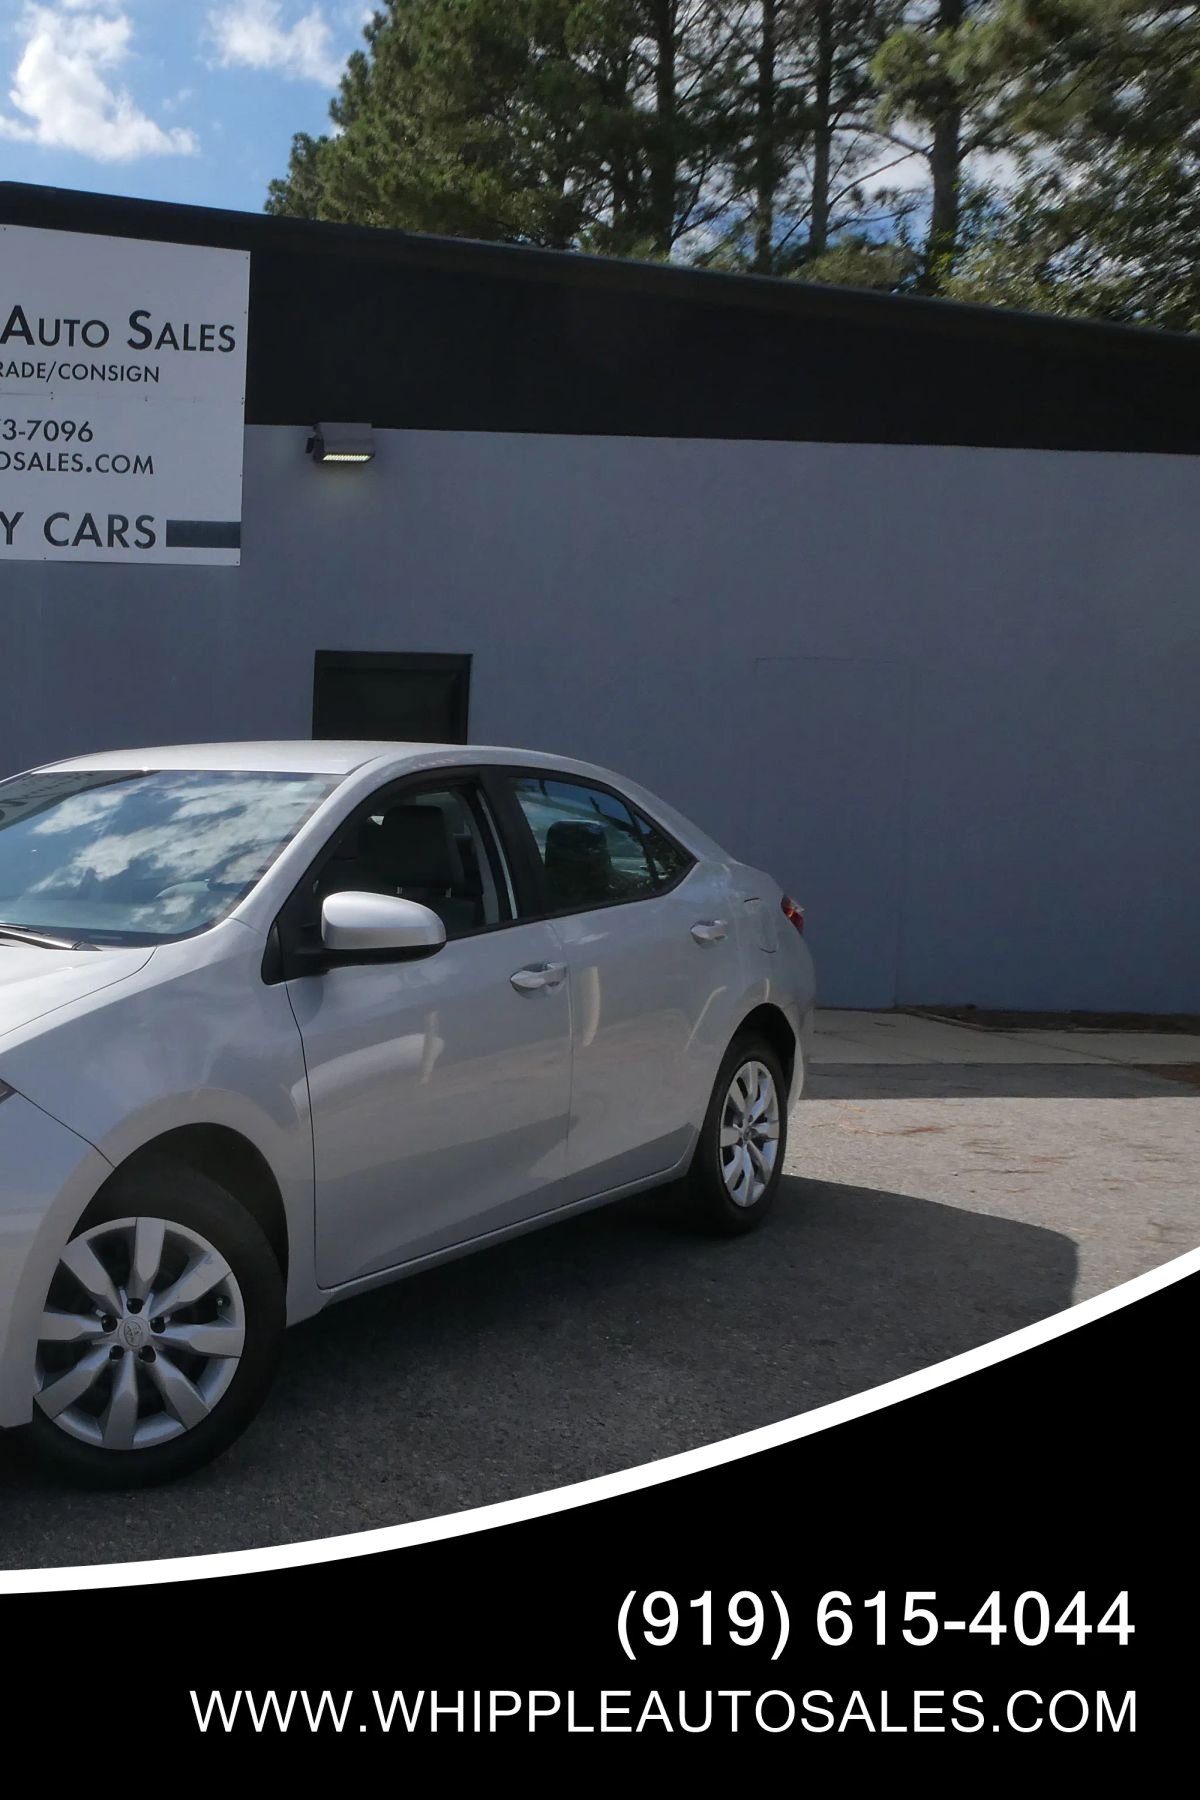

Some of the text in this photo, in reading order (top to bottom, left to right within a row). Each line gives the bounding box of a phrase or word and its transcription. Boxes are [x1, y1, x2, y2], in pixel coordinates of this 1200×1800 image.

[0, 305, 111, 350] AUTO
[126, 310, 237, 353] SALES
[43, 512, 157, 549] CARS
